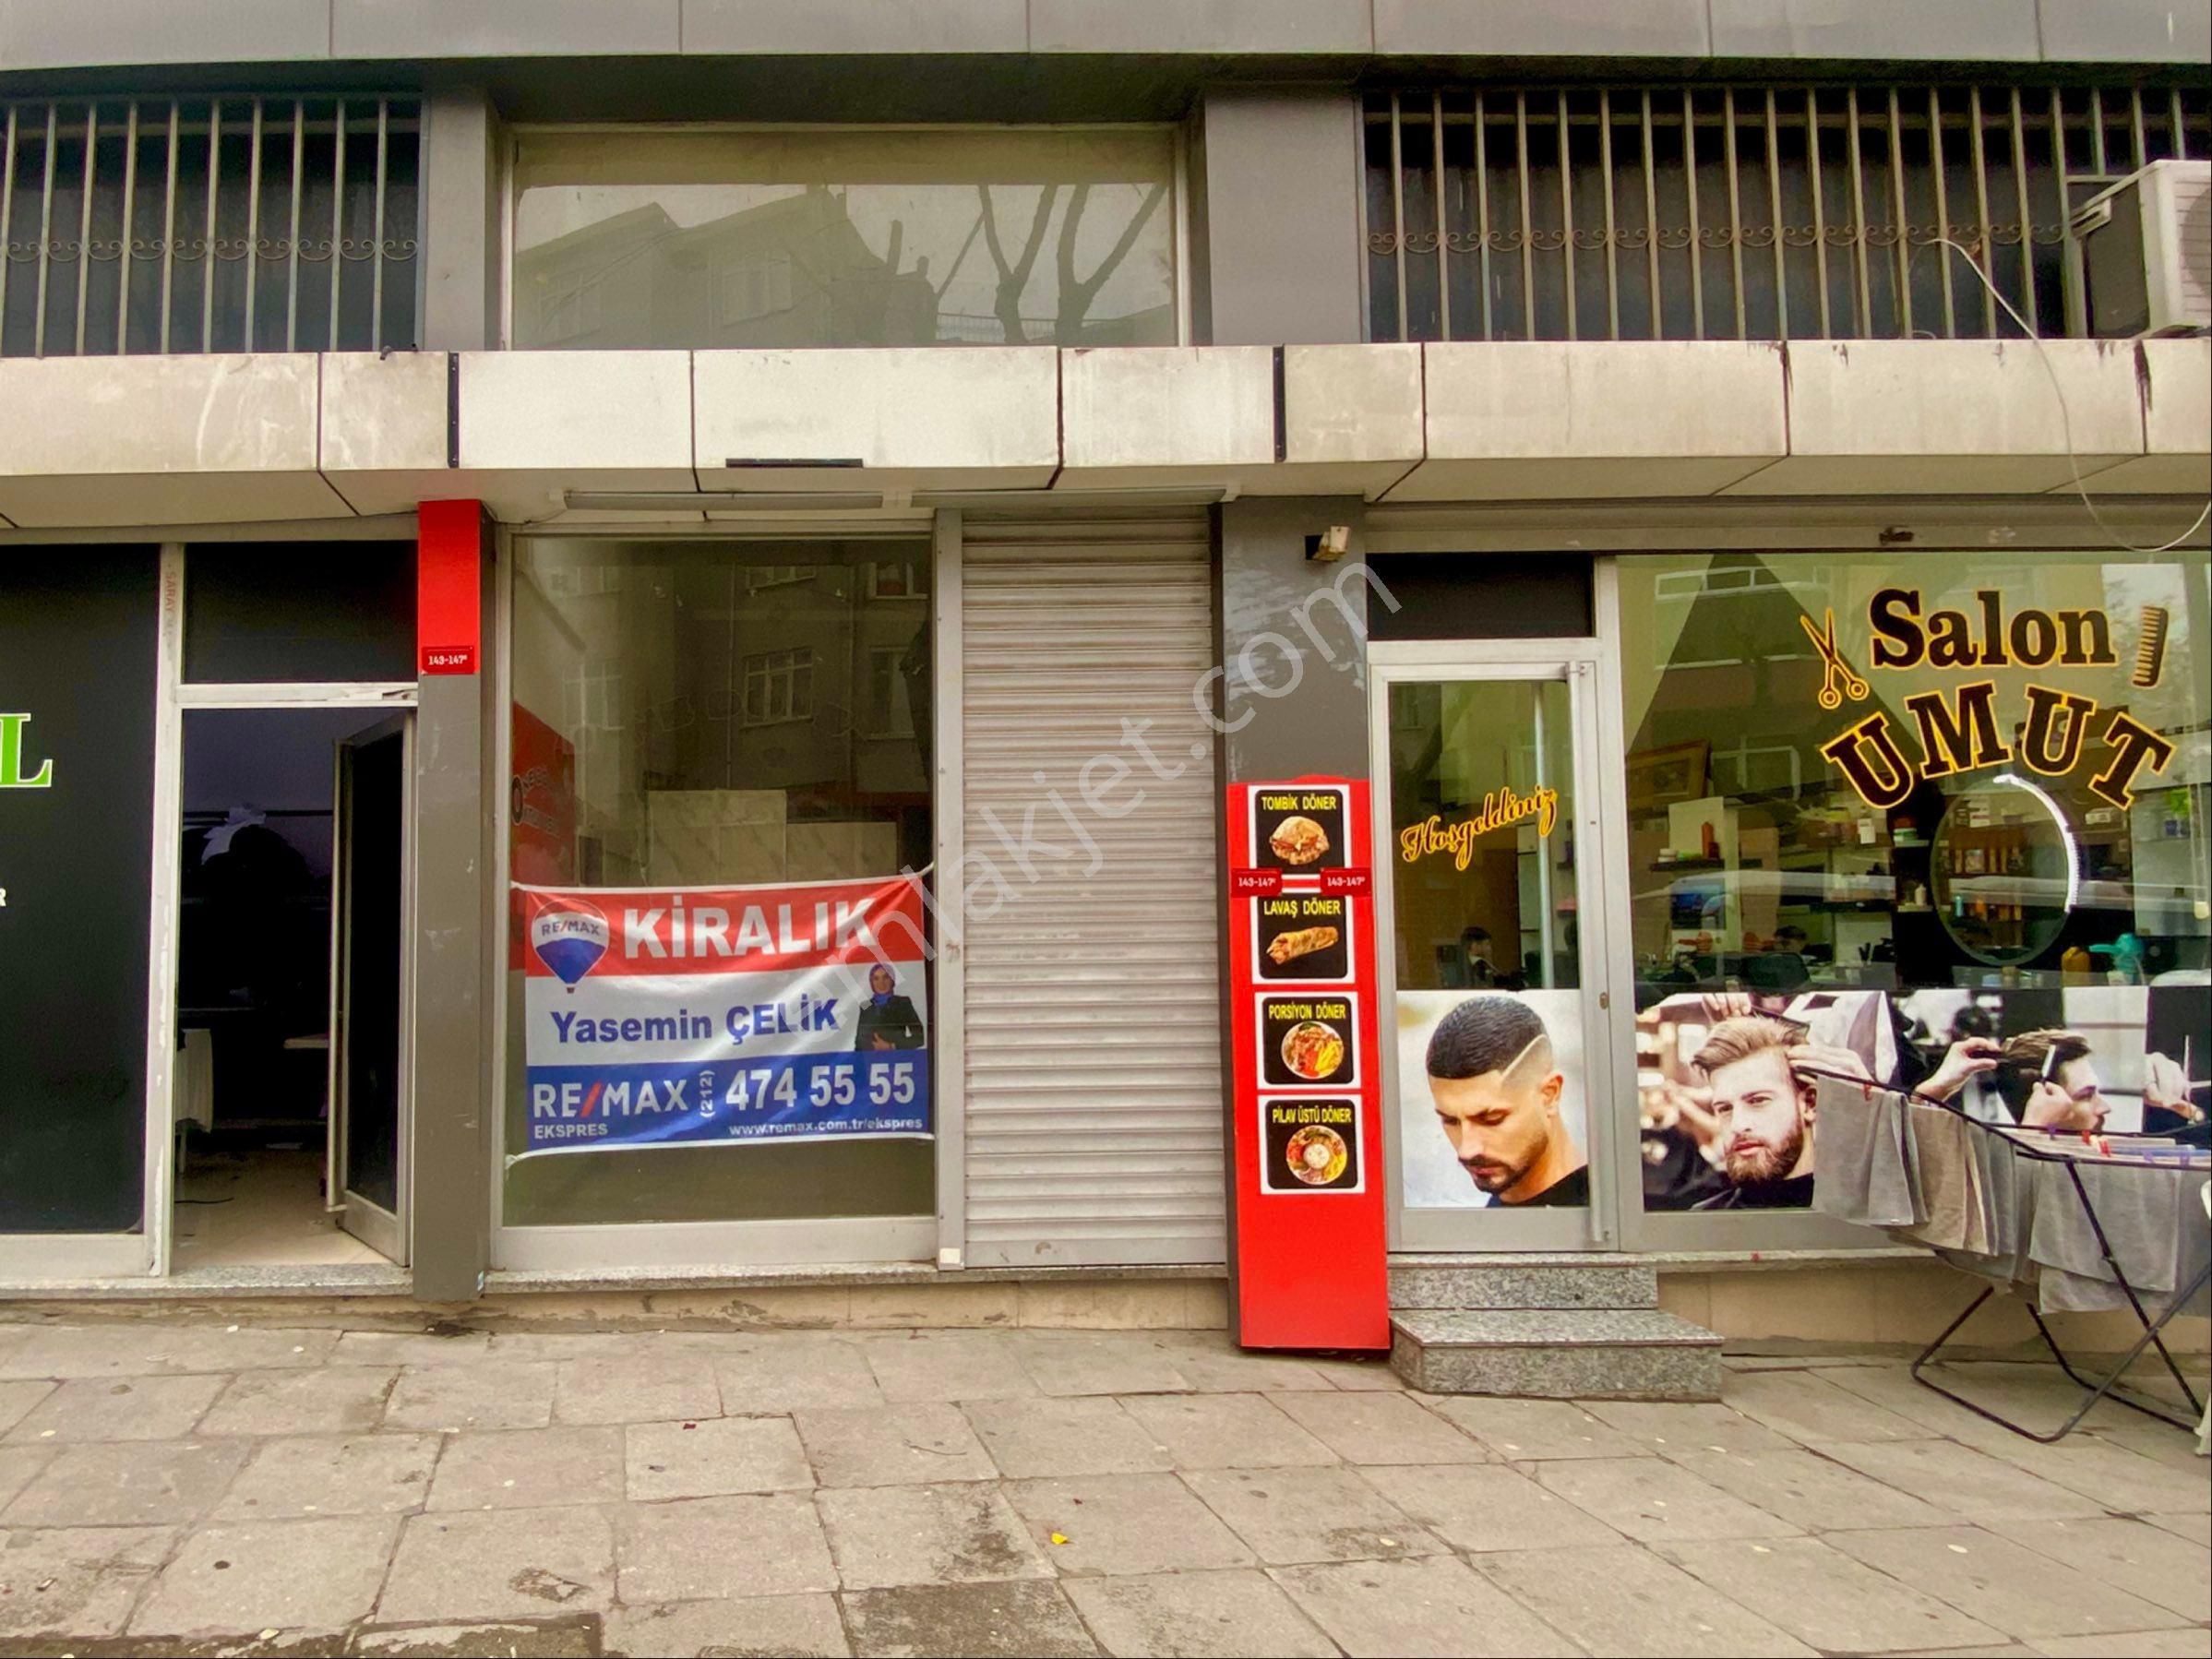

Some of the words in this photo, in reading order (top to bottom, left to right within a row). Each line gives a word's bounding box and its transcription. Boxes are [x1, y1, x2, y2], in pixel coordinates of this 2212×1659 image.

[1869, 588, 2118, 670] Salon
[1820, 680, 2177, 811] UMUT
[1261, 794, 1298, 810] TOMBİK
[1302, 794, 1337, 810] DÖNER
[1263, 901, 1298, 918] LAVAŞ
[1303, 898, 1341, 915] DÖNER
[542, 920, 599, 937] RE/MAX
[624, 895, 878, 959] KİRALIK
[551, 1009, 712, 1044] Yasemin
[726, 994, 840, 1045] ÇELİK
[1269, 1002, 1312, 1020] PORSİYON
[1316, 1002, 1346, 1020] DÖNER
[532, 1080, 688, 1118] RE/MAX
[699, 1070, 716, 1118] (212)
[724, 1068, 797, 1111] 474
[809, 1065, 855, 1107] 55
[868, 1062, 915, 1105] 55
[1273, 1105, 1297, 1123] PİLAV
[1297, 1105, 1320, 1123] ÜSTÜ
[1321, 1105, 1352, 1123] DÖNER
[533, 1123, 608, 1140] EKSPRES
[728, 1116, 923, 1136] www.remax.com.tr/ekspres
